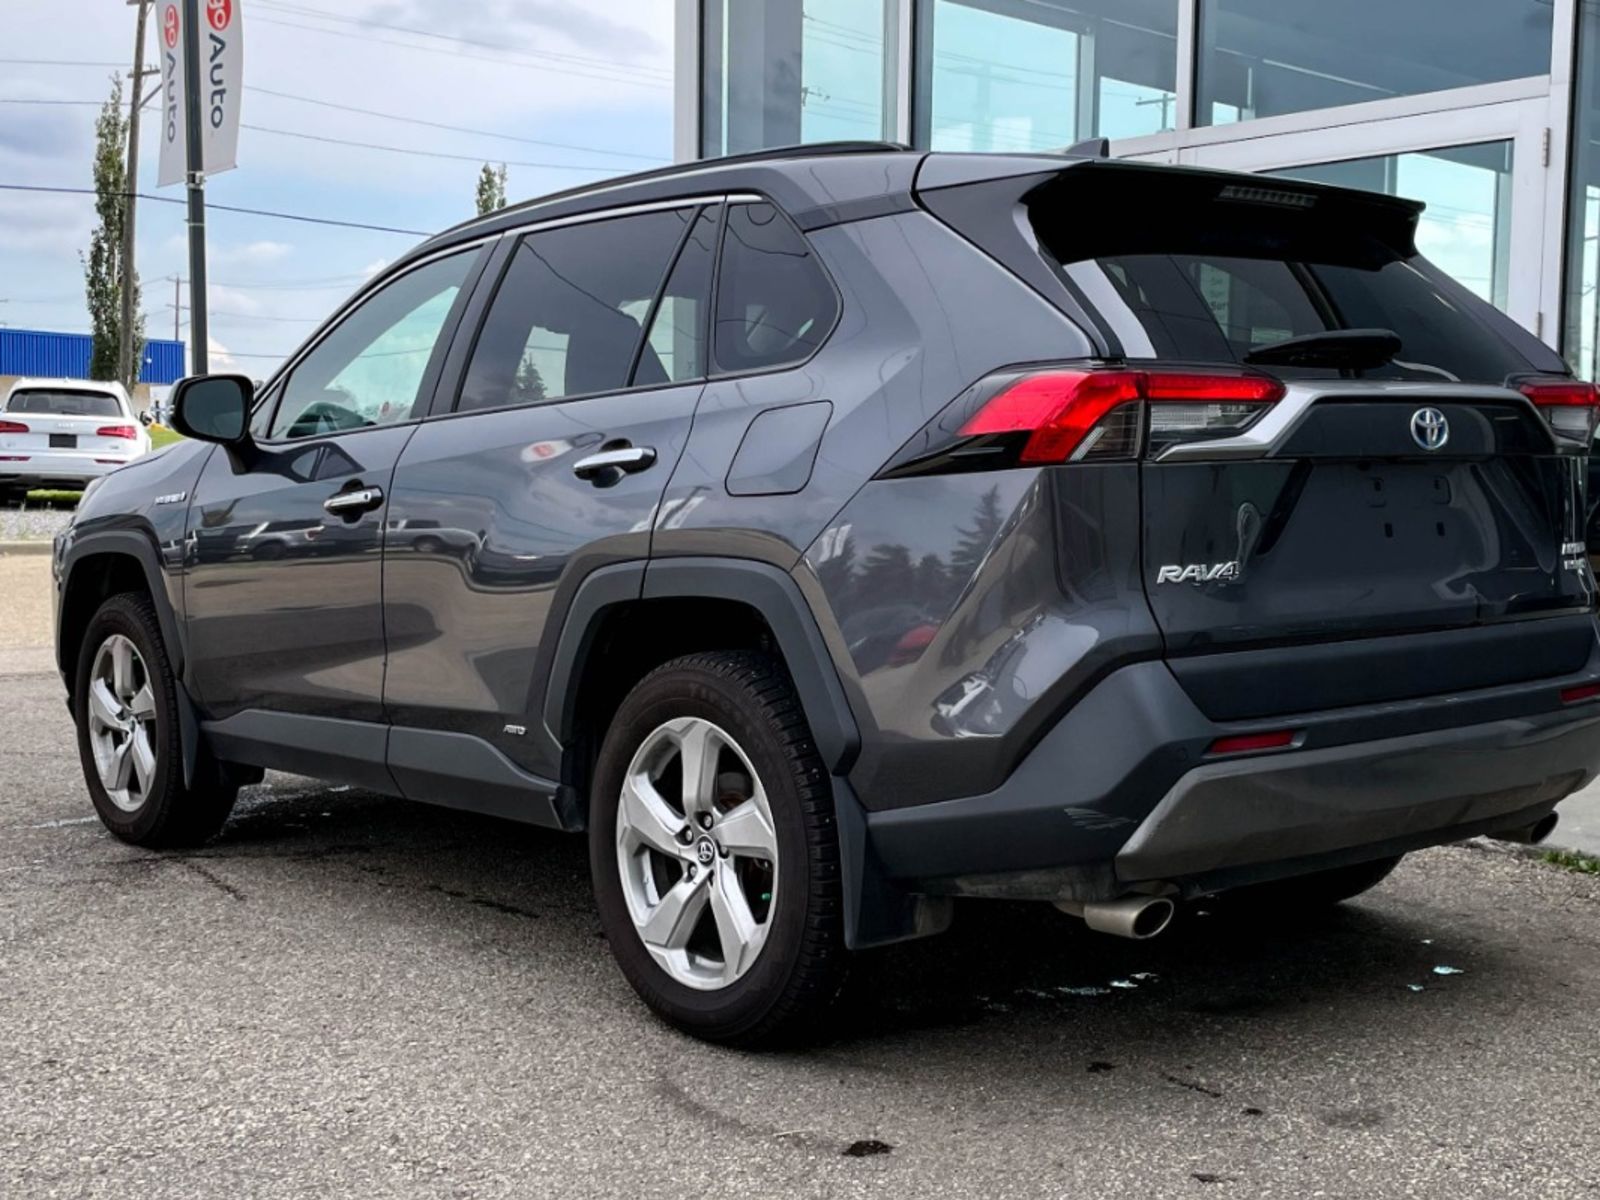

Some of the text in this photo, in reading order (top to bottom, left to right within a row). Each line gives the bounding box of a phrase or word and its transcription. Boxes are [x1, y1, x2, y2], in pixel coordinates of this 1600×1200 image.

[166, 52, 177, 143] Auto
[209, 33, 226, 128] Auto
[1156, 561, 1239, 584] RAV4
